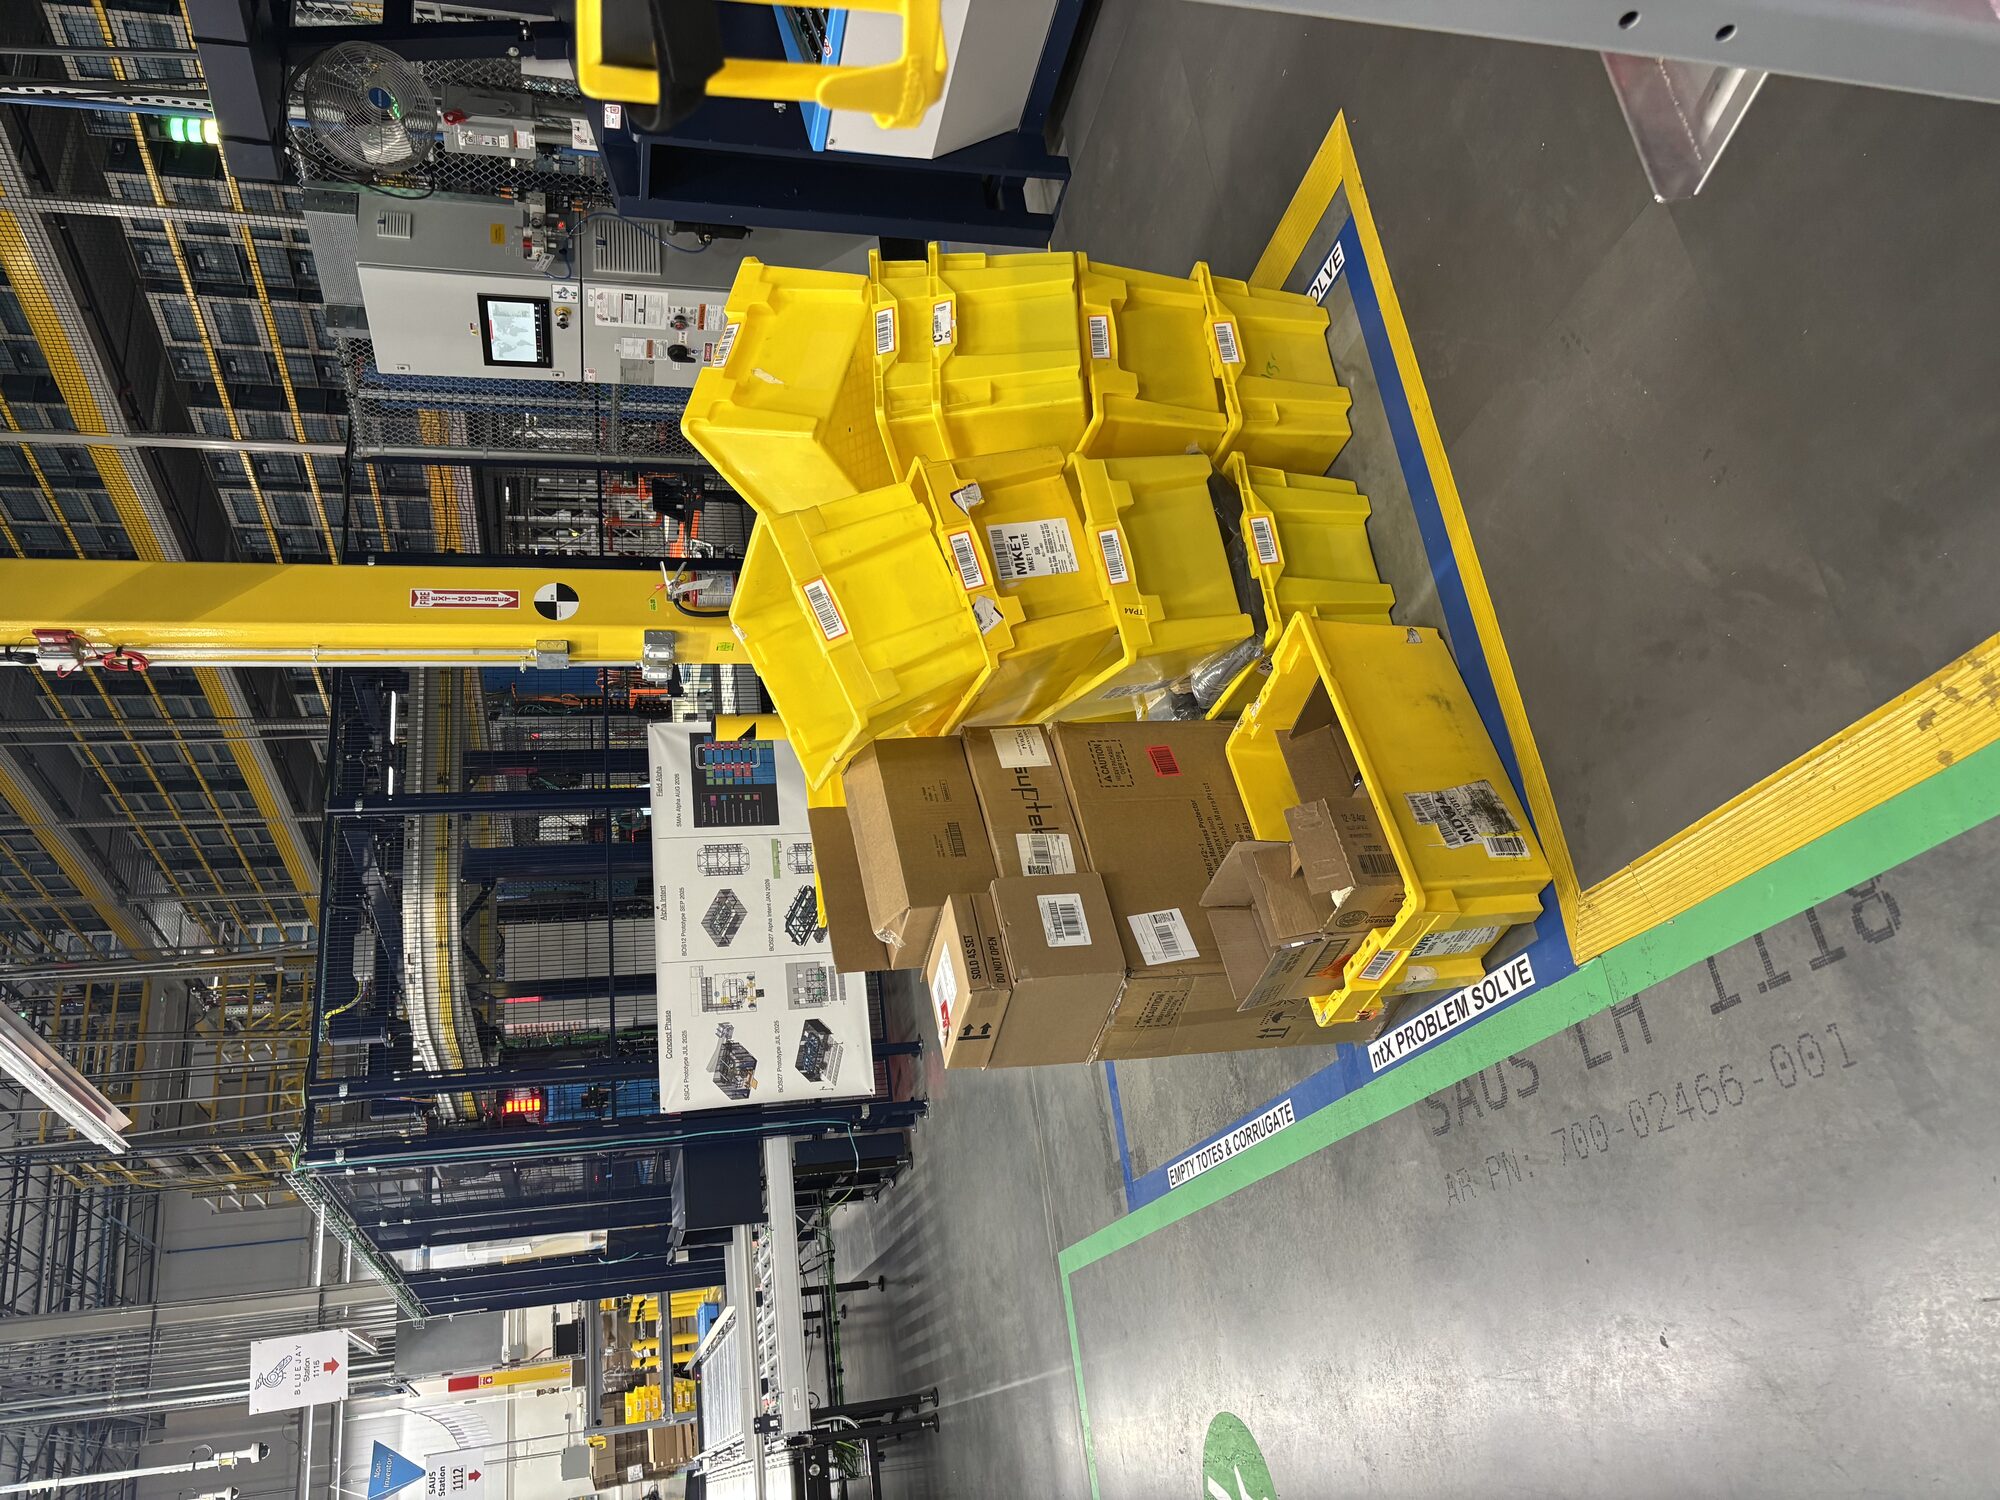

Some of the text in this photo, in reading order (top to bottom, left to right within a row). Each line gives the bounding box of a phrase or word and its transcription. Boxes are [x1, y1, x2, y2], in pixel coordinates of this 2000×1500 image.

[1008, 535, 1028, 575] MKE1
[419, 592, 430, 605] FIRE
[1124, 607, 1144, 616] TPA4
[1094, 744, 1110, 775] CAUTION
[1191, 800, 1206, 828] Protector
[1207, 816, 1216, 829] inch
[1435, 796, 1474, 843] MDW4
[1202, 829, 1216, 856] Mattress
[963, 934, 982, 979] SOLD AS SET
[988, 936, 1006, 983] DO NOT OPEN
[1145, 994, 1165, 1018] CAUTION
[1372, 958, 1532, 1068] ntX PROBLEM SOLVE
[1550, 1022, 1857, 1167] 700-02466-001
[1169, 1103, 1293, 1185] EMPTY TOTES & CORRUGATE
[294, 1344, 302, 1396] BLUEJAY
[384, 1453, 394, 1488] Inventory
[428, 1471, 436, 1495] SAUS
[438, 1466, 446, 1496] Station
[452, 1467, 464, 1491] 1112
